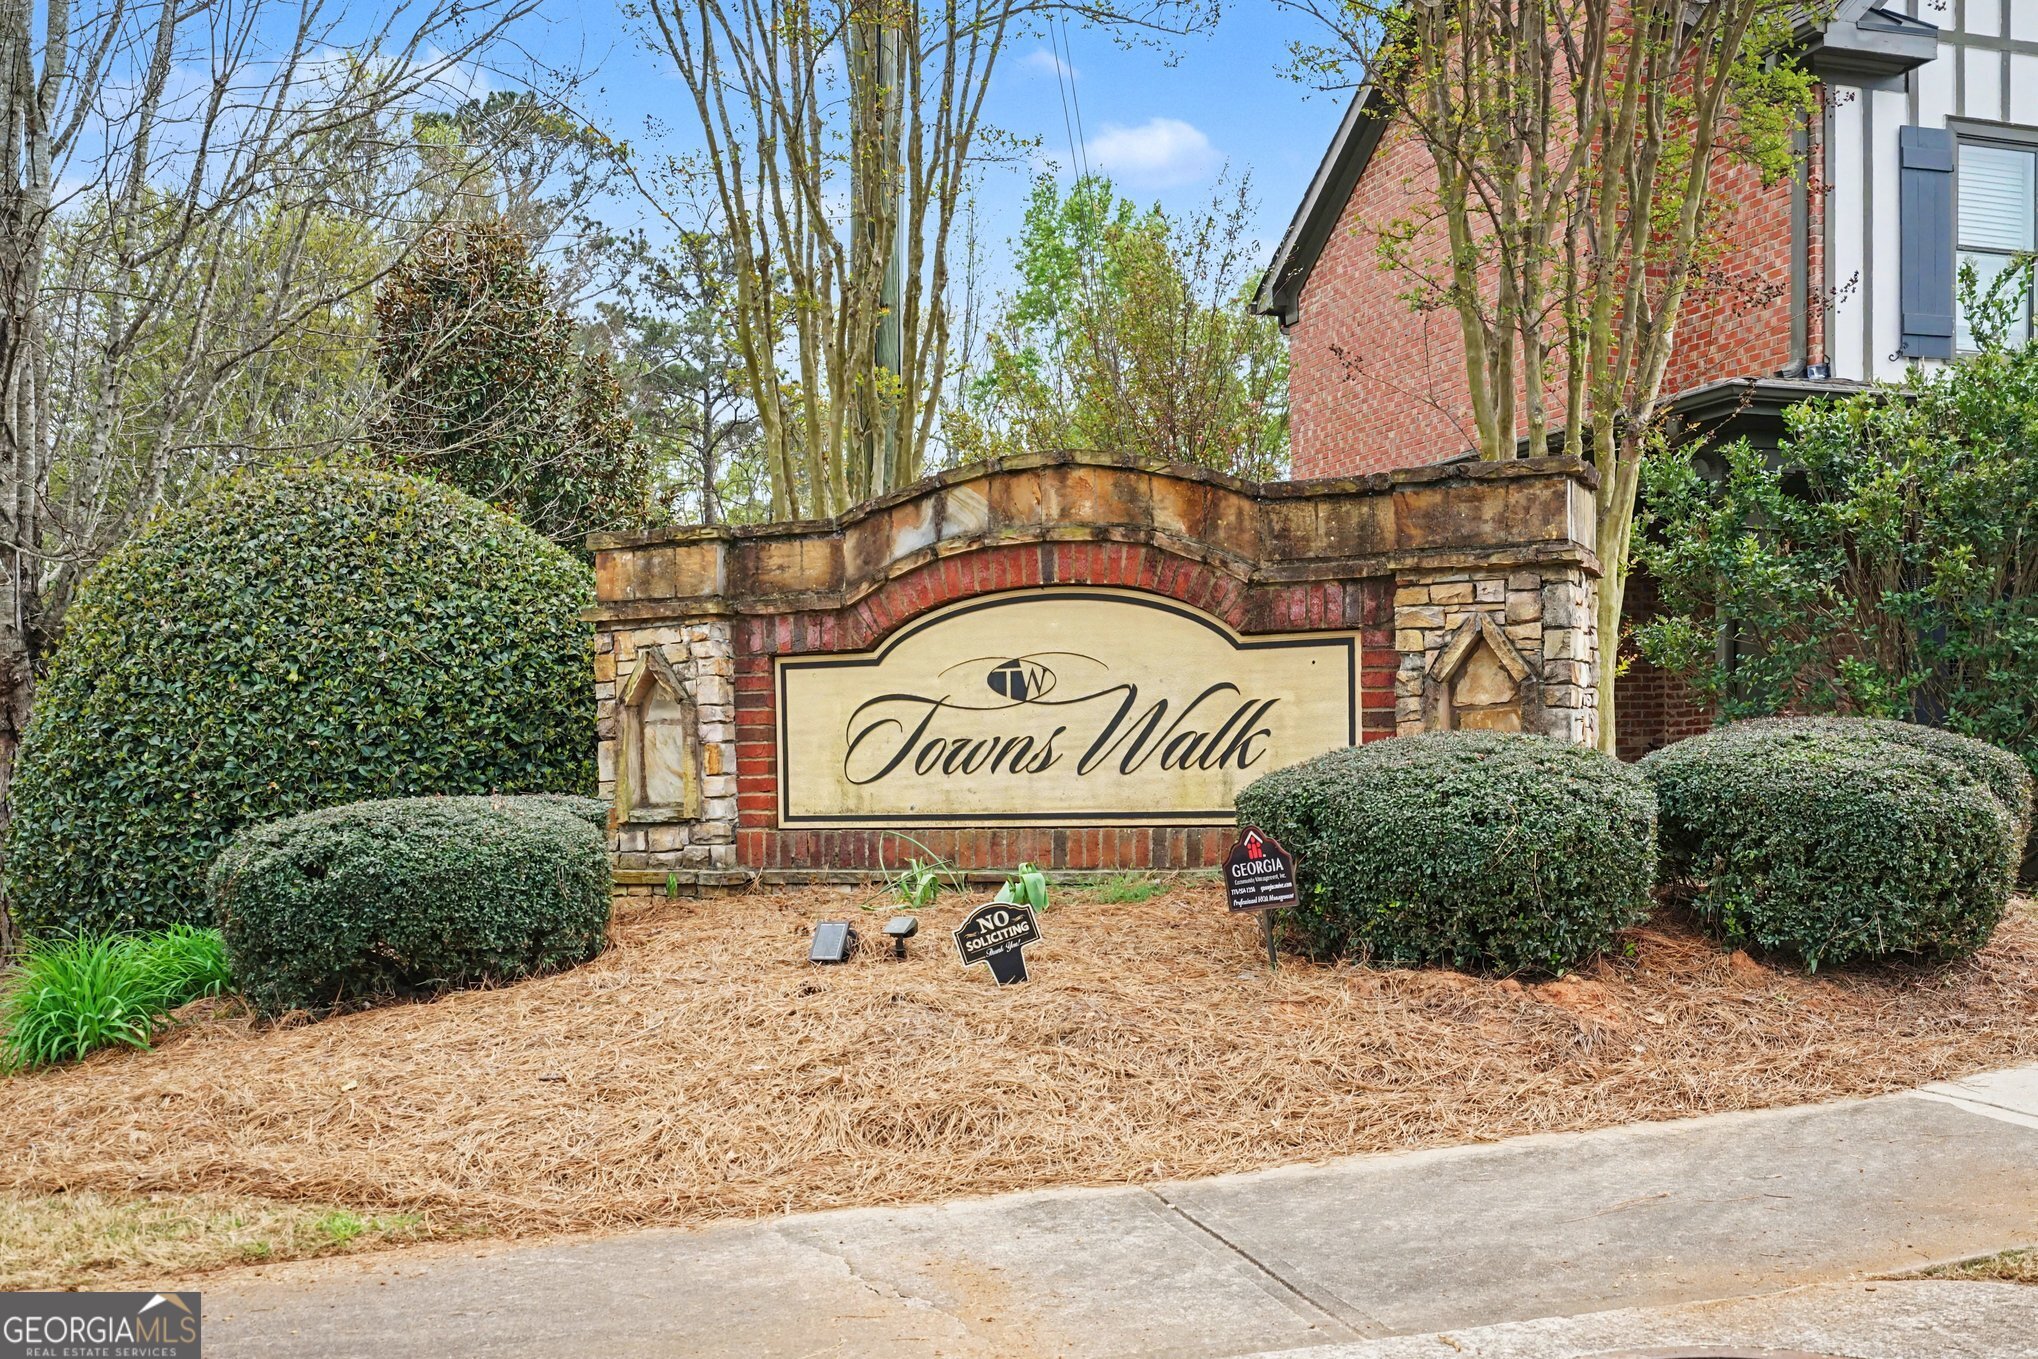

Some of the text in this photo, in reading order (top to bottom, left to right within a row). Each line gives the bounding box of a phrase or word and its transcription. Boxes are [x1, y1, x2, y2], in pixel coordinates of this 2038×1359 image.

[844, 682, 1281, 785] Towns Walk
[1231, 857, 1284, 877] GEORGIA
[976, 910, 1009, 934] NO
[965, 921, 1030, 952] SOLICITING
